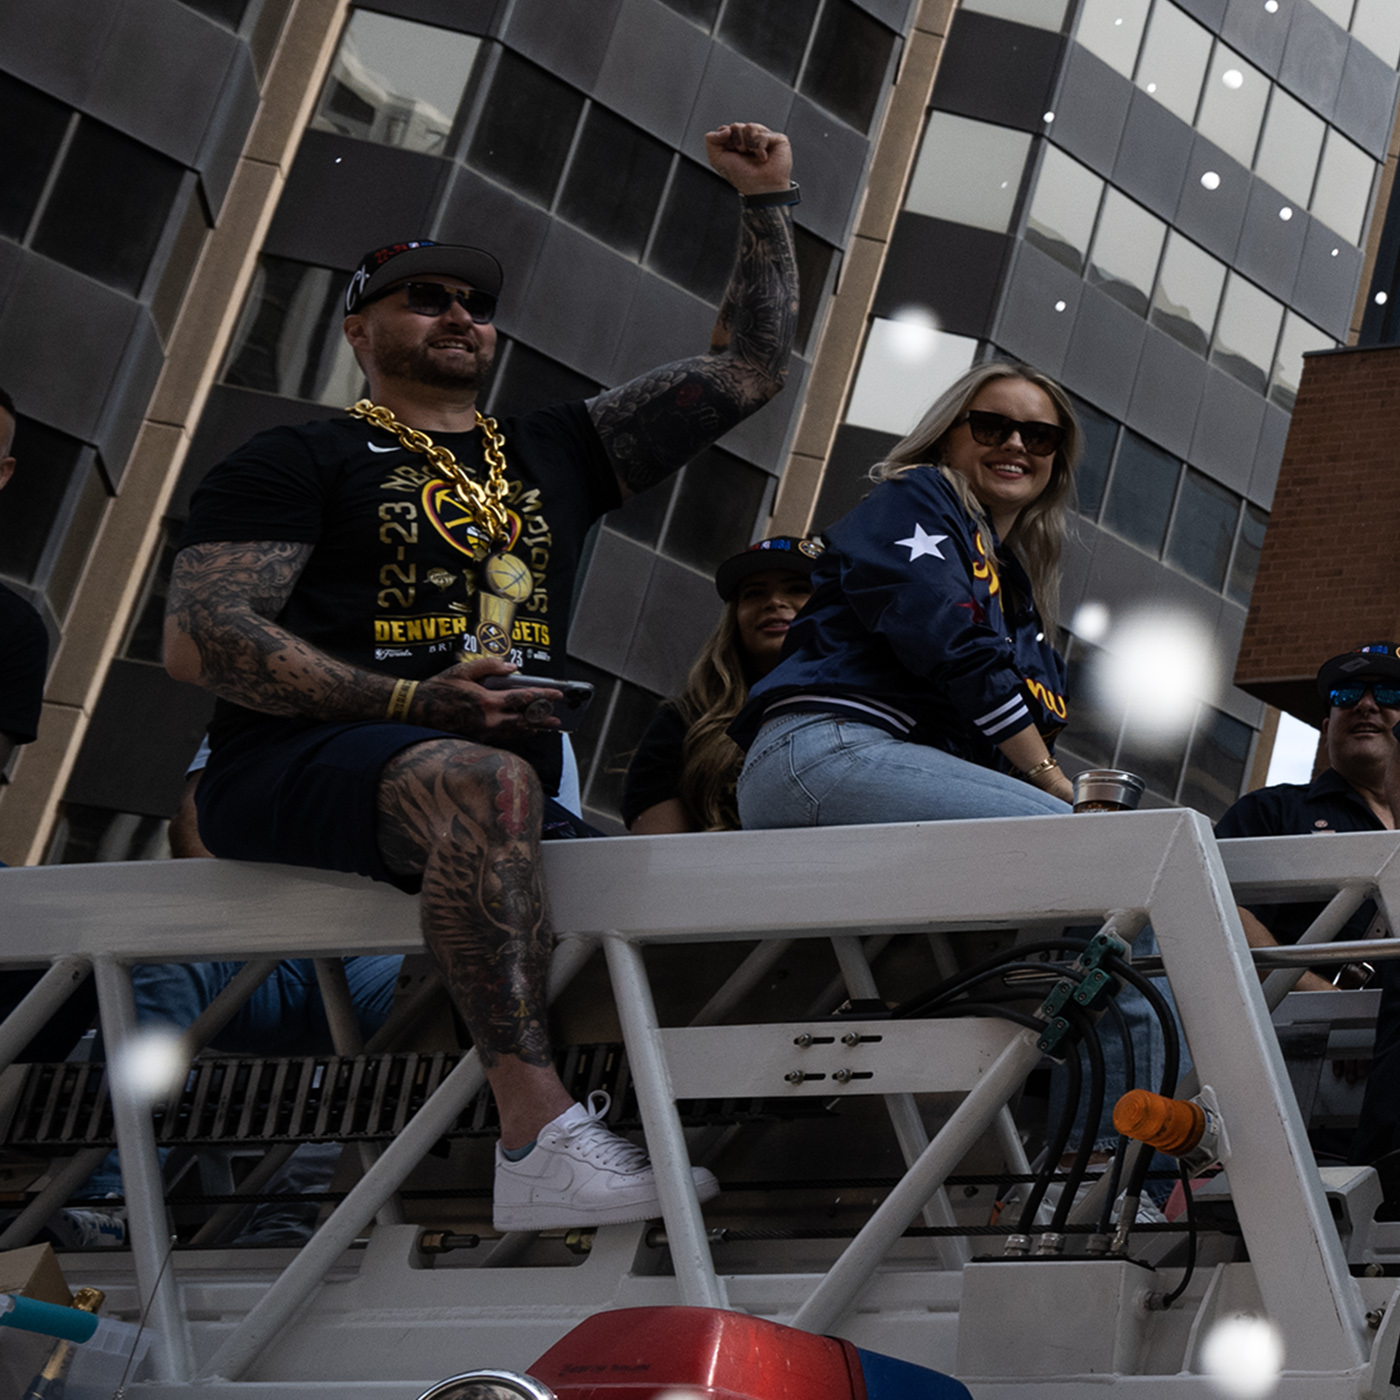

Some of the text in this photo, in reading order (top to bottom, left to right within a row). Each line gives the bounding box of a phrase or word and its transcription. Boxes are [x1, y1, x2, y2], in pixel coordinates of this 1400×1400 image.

[377, 501, 419, 609] 22-23
[374, 617, 468, 642] DENVER
[463, 633, 478, 651] 20
[511, 648, 523, 667] 23
